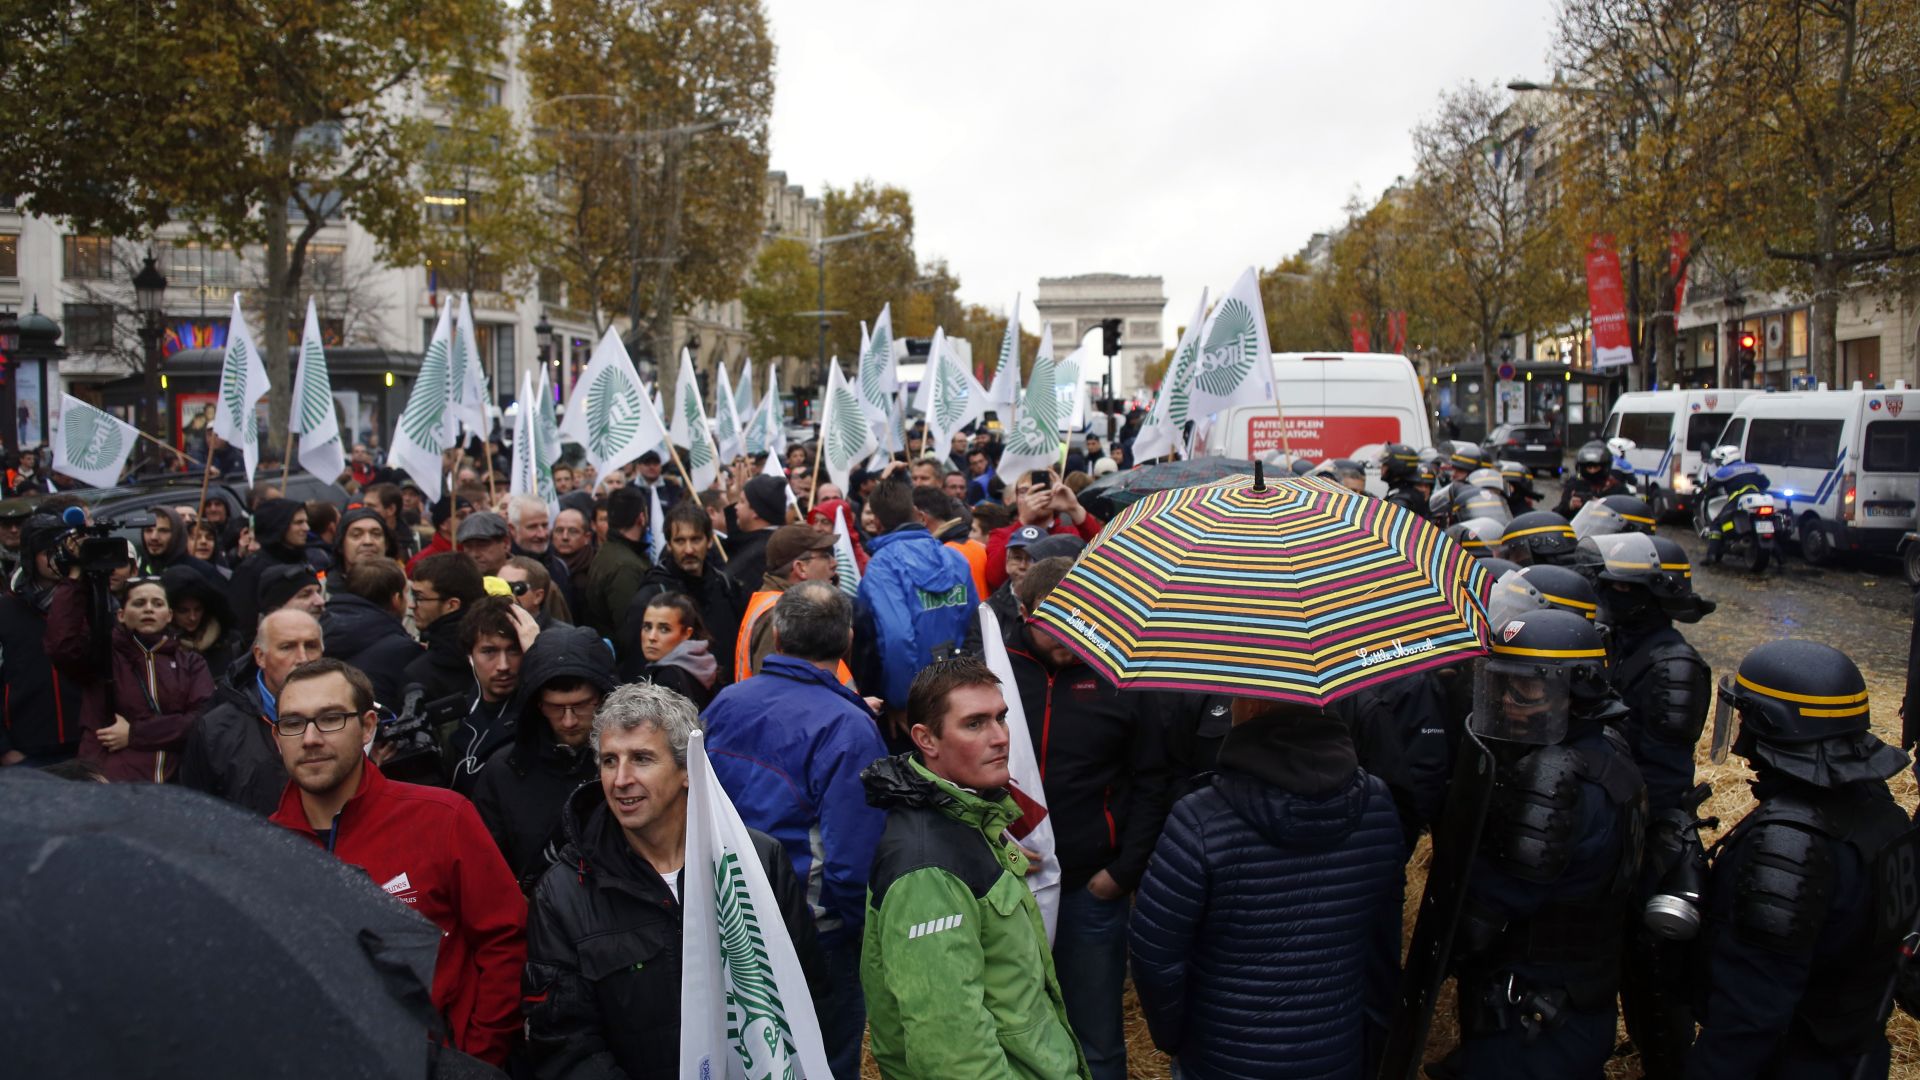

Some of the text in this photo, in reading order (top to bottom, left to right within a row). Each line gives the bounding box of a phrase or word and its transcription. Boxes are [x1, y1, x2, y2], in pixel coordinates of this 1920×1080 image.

[1253, 420, 1324, 428] FAITES LE PLEIN
[1253, 430, 1320, 439] DE LOATION,
[1253, 440, 1278, 448] AVEC
[1066, 607, 1111, 653] Little Marcel
[1356, 637, 1436, 667] Little Marcel
